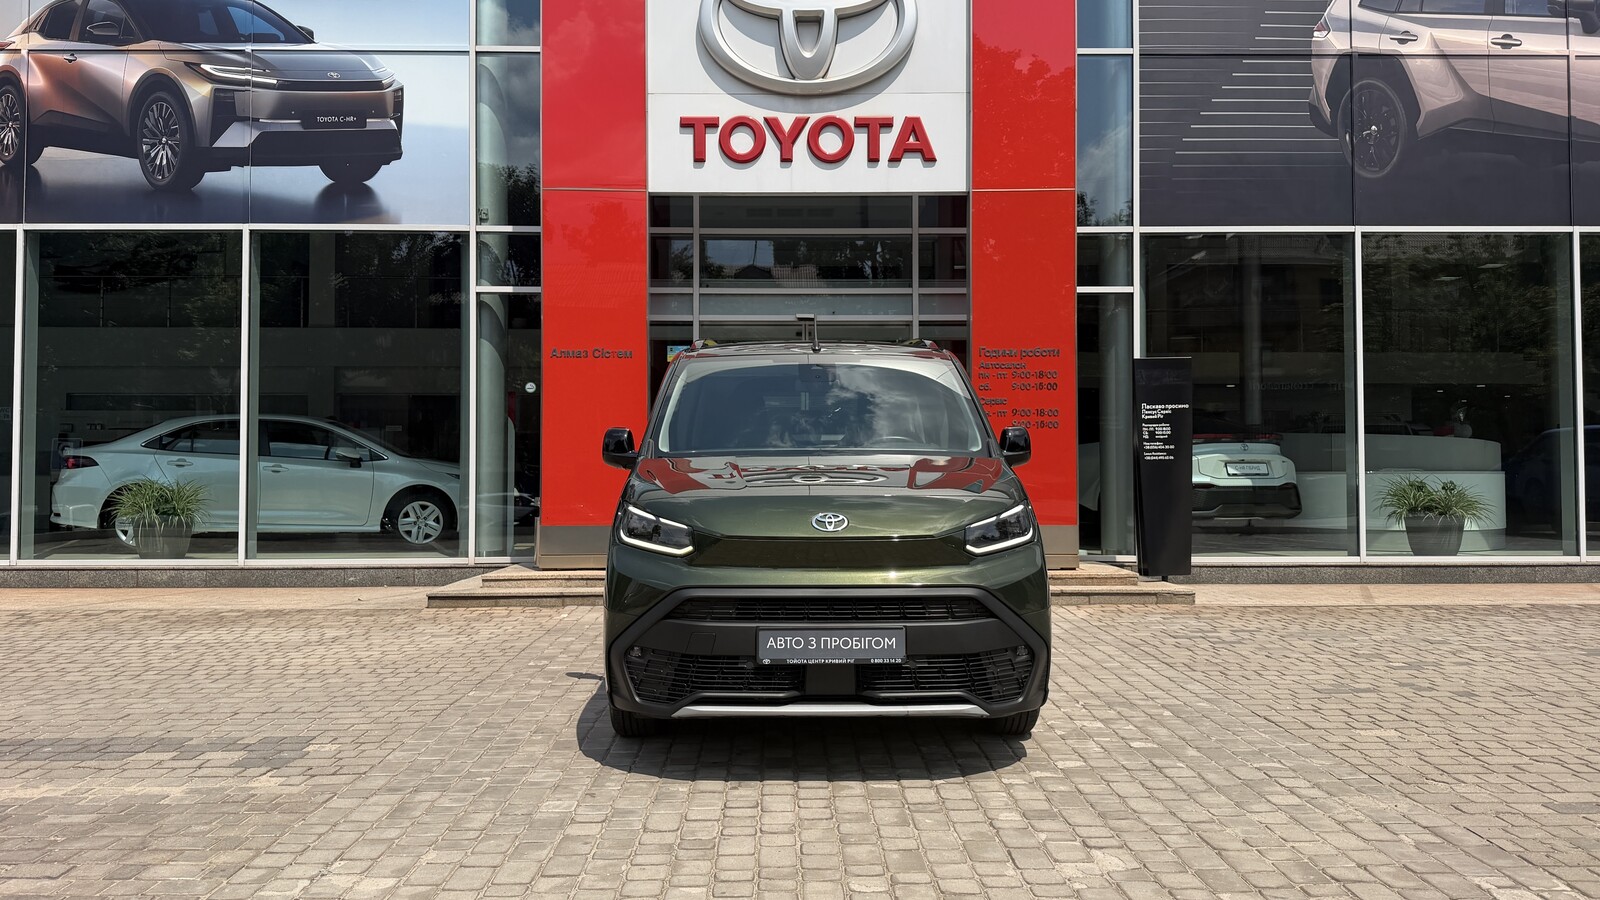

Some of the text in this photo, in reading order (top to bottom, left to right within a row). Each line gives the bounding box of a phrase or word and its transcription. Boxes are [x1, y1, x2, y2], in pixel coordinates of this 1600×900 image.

[679, 115, 937, 164] TOYOTA
[550, 347, 633, 358] Алмаз Сістем
[978, 347, 1060, 360] Години роботи
[978, 361, 1026, 369] Автосалон
[1011, 371, 1058, 379] 9:00-18:00
[980, 398, 1008, 407] Сервіс
[1011, 408, 1059, 417] 9:00-18:00
[766, 637, 804, 649] АВТО
[821, 637, 896, 649] ПРОБІГОМ
